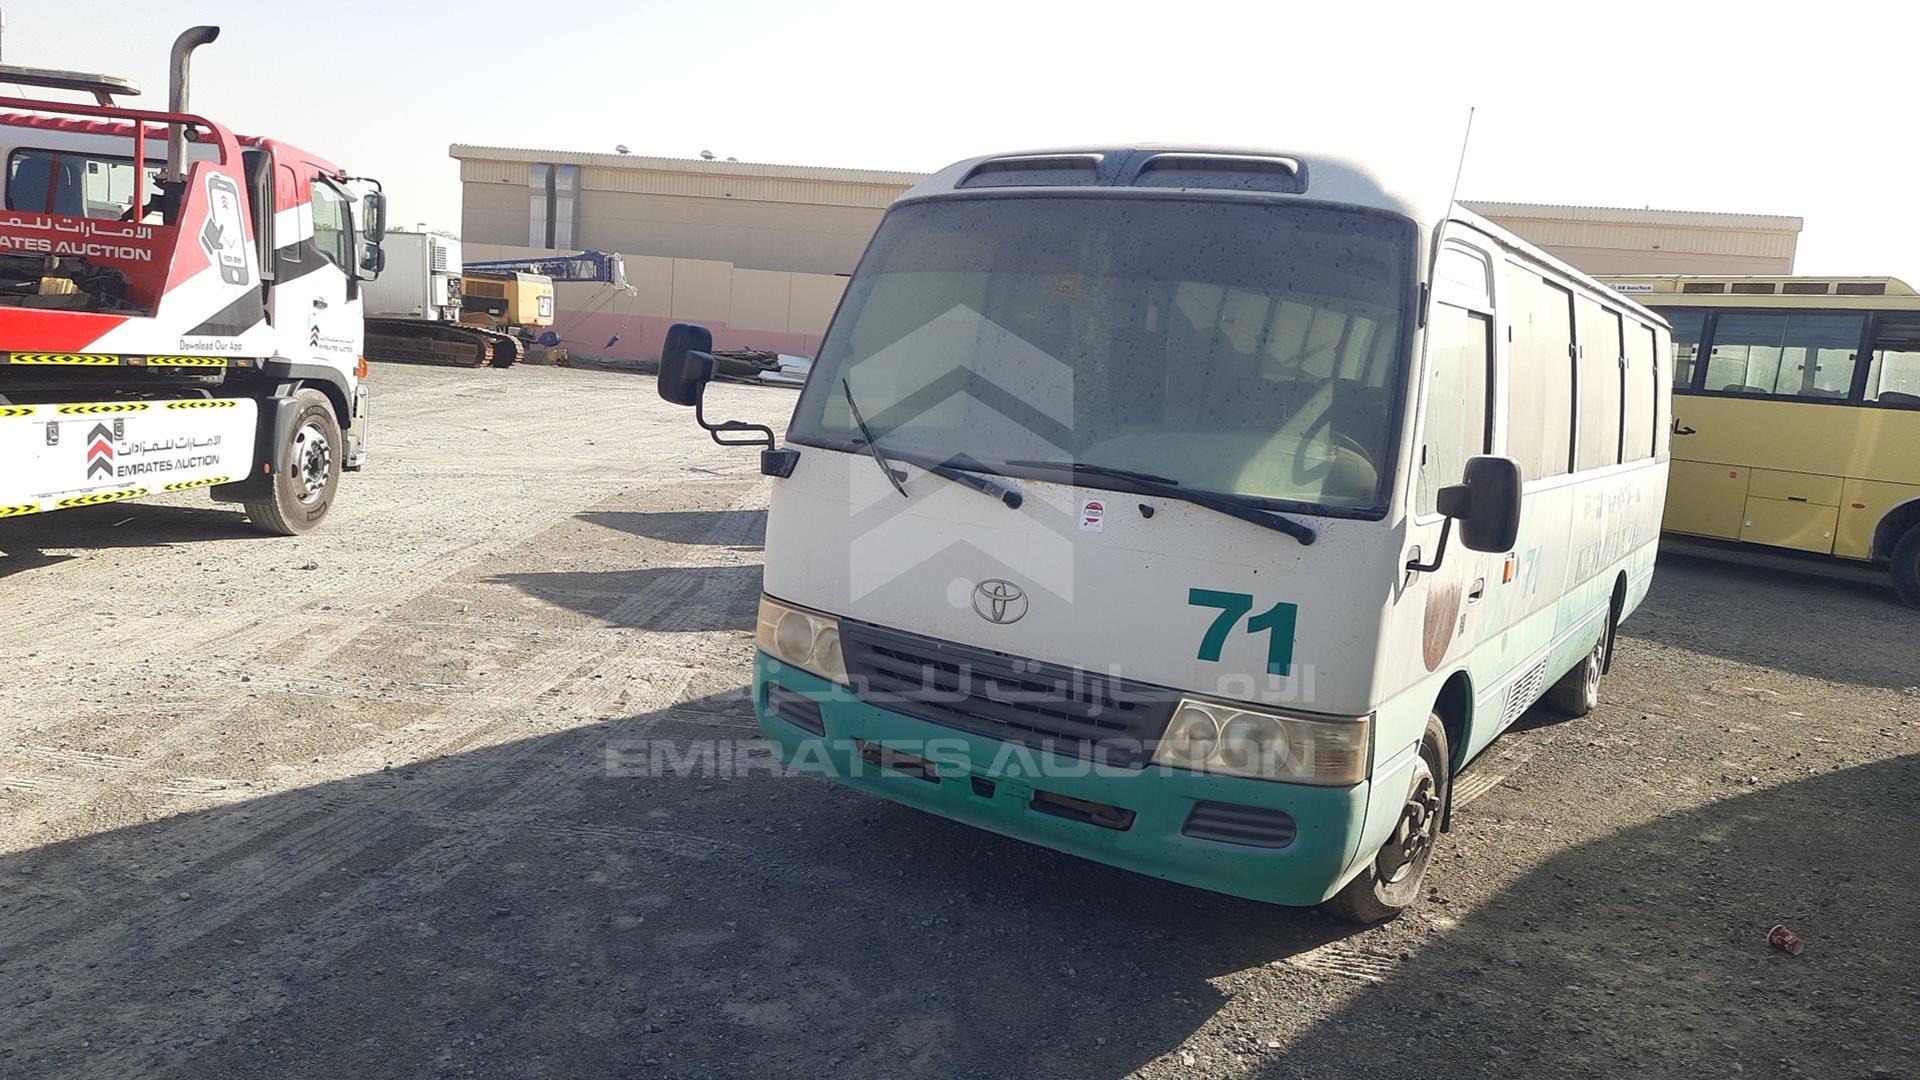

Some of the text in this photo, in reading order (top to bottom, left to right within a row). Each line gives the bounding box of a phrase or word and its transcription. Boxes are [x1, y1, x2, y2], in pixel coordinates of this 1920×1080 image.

[55, 240, 152, 261] AUCTION
[179, 339, 242, 352] Download Our App
[174, 455, 220, 470] AUCTION
[1188, 587, 1298, 677] 71
